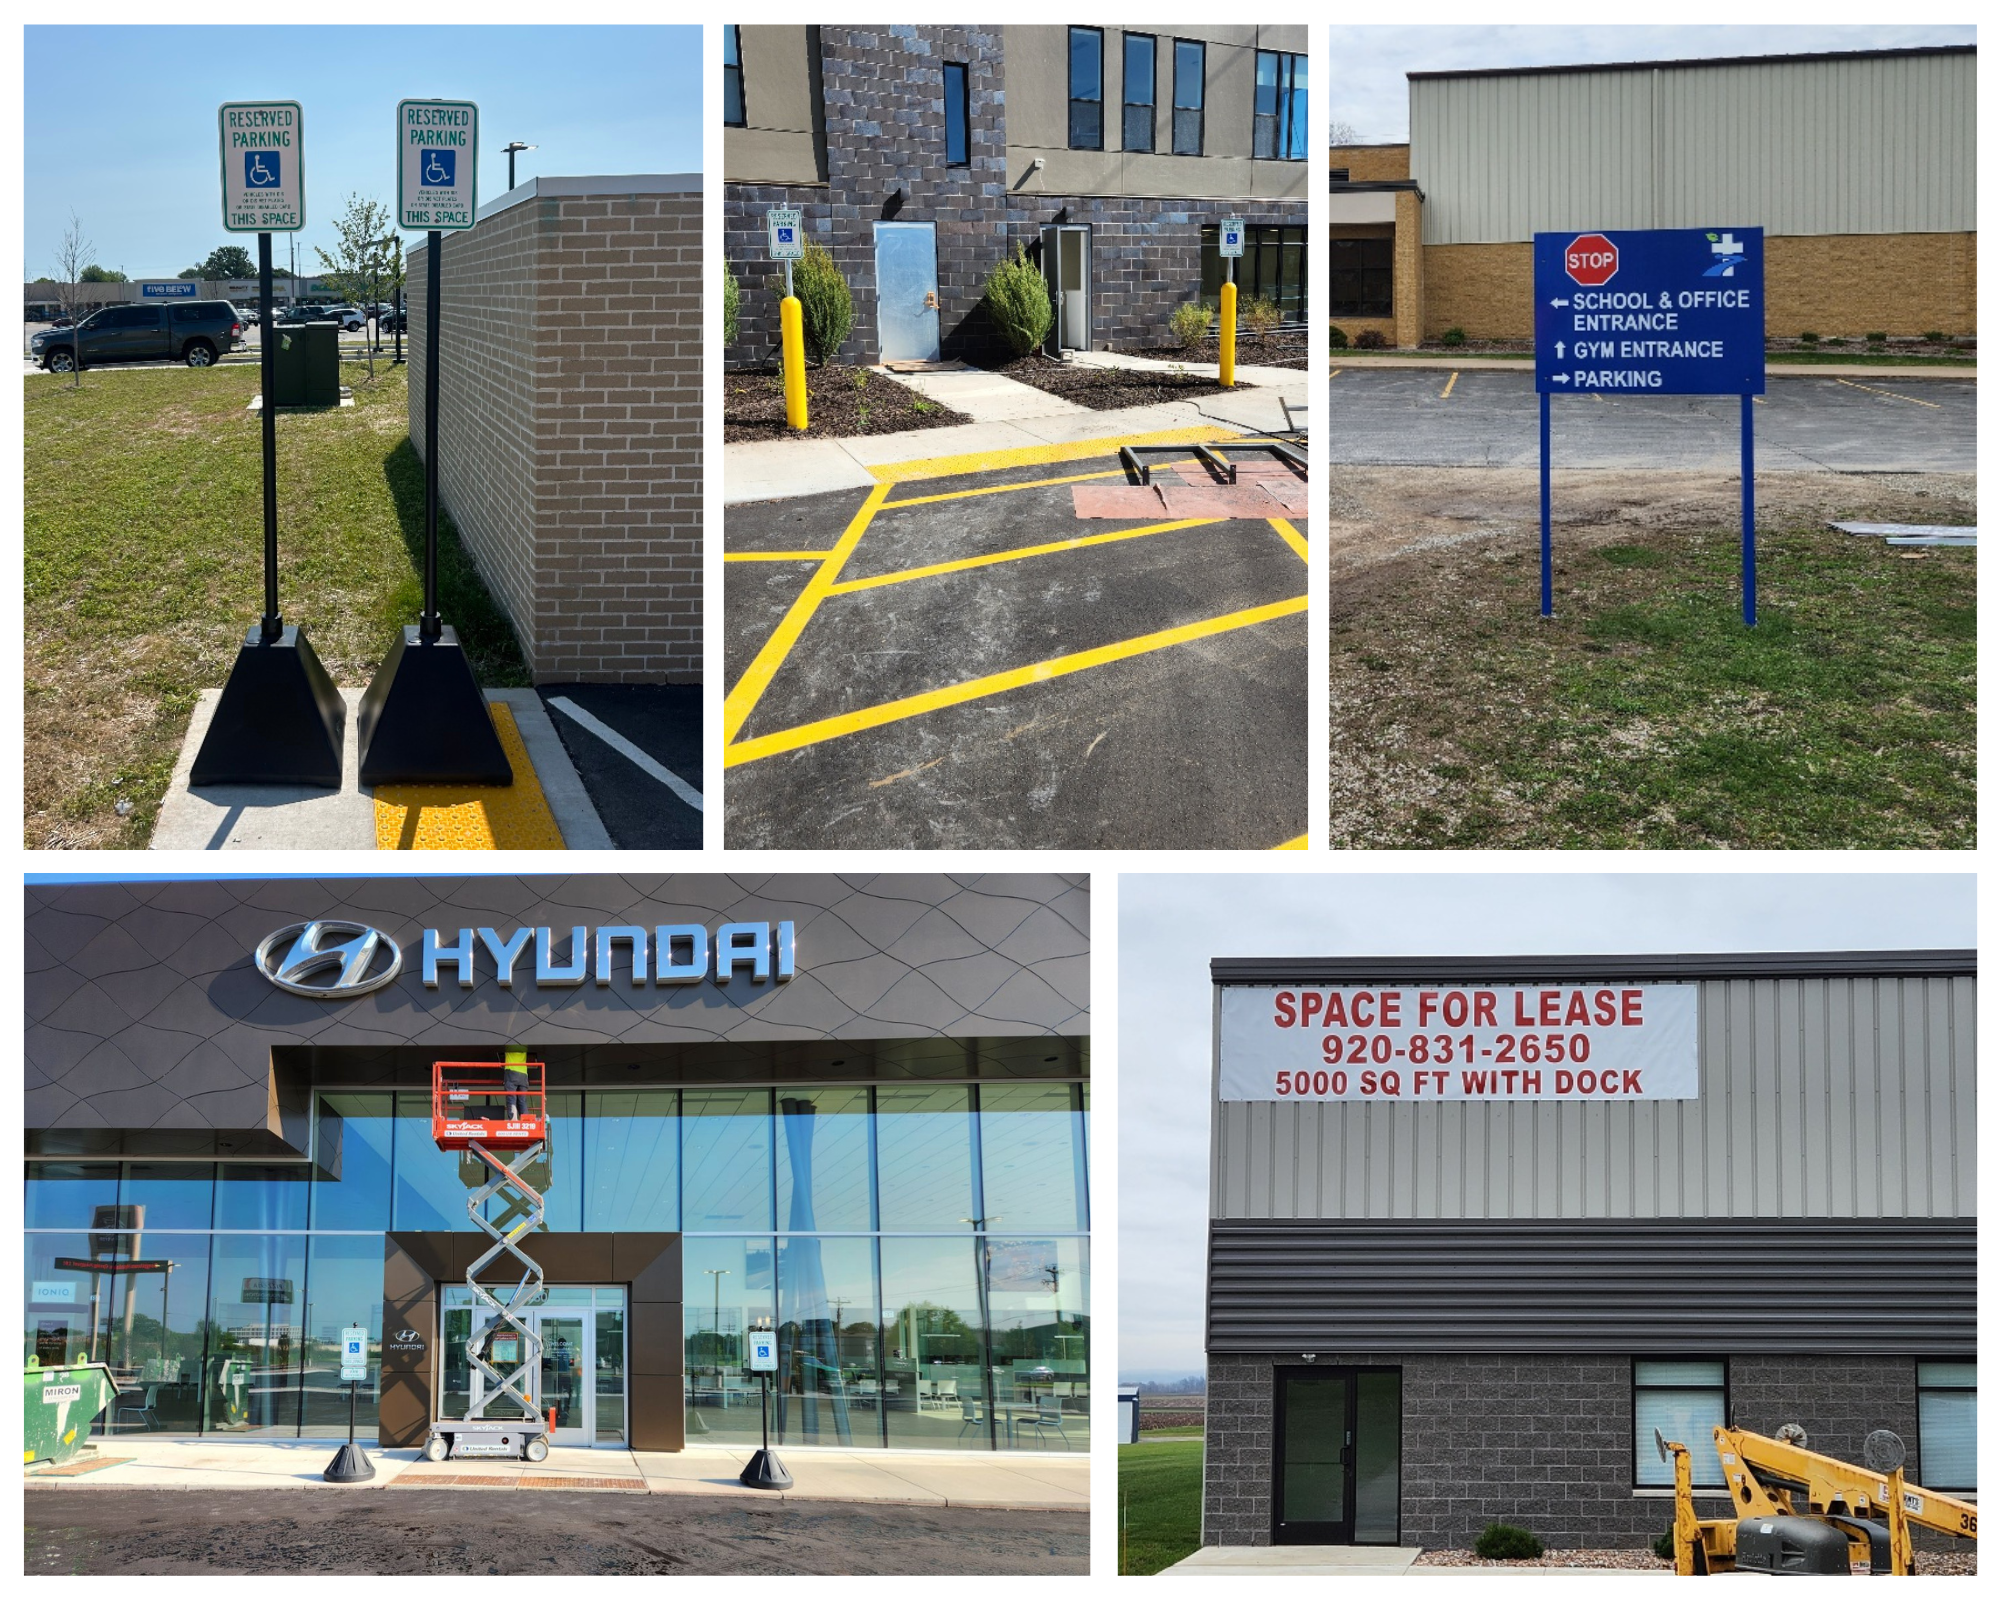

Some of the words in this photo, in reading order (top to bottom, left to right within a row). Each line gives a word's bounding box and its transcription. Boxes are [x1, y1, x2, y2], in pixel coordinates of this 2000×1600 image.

[229, 110, 292, 128] RESERVED
[408, 108, 469, 126] RESERVED
[232, 131, 290, 148] PARKING
[410, 129, 466, 147] PARKING
[231, 213, 256, 225] THIS
[262, 213, 297, 225] SPACE
[406, 211, 430, 223] THIS
[435, 211, 468, 223] SPACE
[1568, 252, 1614, 269] STOP
[1573, 292, 1653, 310] SCHOOL
[1658, 291, 1673, 309] &
[1678, 290, 1750, 308] OFFICE
[1574, 313, 1678, 331] ENTRANCE
[1574, 341, 1614, 358] GYM
[1621, 341, 1723, 358] ENTRANCE
[1574, 370, 1662, 387] PARKING
[422, 920, 796, 988] HYUNDAI
[1274, 991, 1401, 1028] SPACE
[1419, 990, 1498, 1028] FOR
[1514, 989, 1644, 1027] LEASE
[1322, 1033, 1590, 1065] 920-831-2650
[1275, 1071, 1348, 1096] 5000
[1360, 1071, 1401, 1097] SQ
[1414, 1071, 1450, 1096] FT
[1461, 1070, 1542, 1095] WITH
[1555, 1069, 1643, 1094] DOCK
[446, 1121, 484, 1130] SKYJACK
[38, 1288, 69, 1296] IONIQ
[472, 1286, 496, 1309] SKYJACK
[45, 1387, 79, 1396] MIRON
